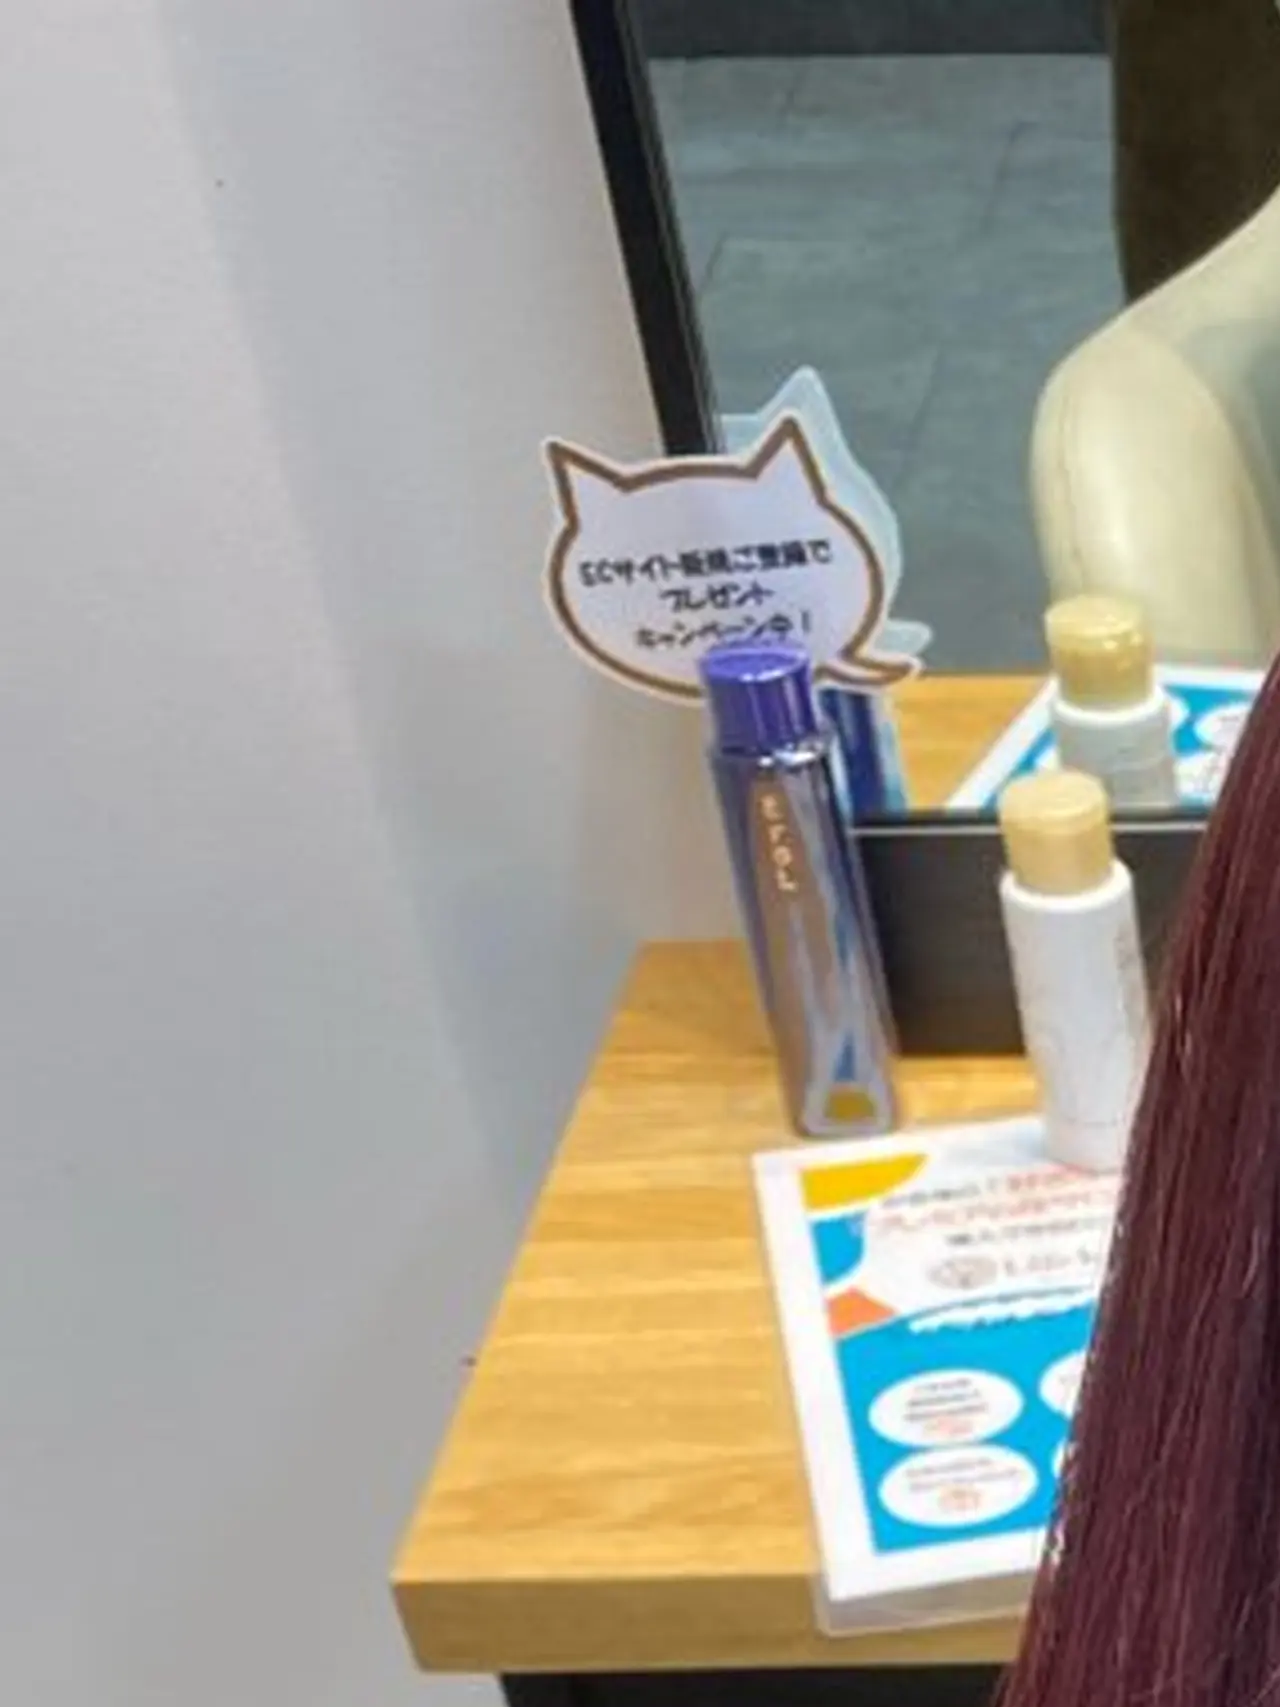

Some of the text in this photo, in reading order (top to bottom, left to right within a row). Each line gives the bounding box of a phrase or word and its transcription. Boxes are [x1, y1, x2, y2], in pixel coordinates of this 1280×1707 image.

[660, 580, 776, 612] プレゼント
